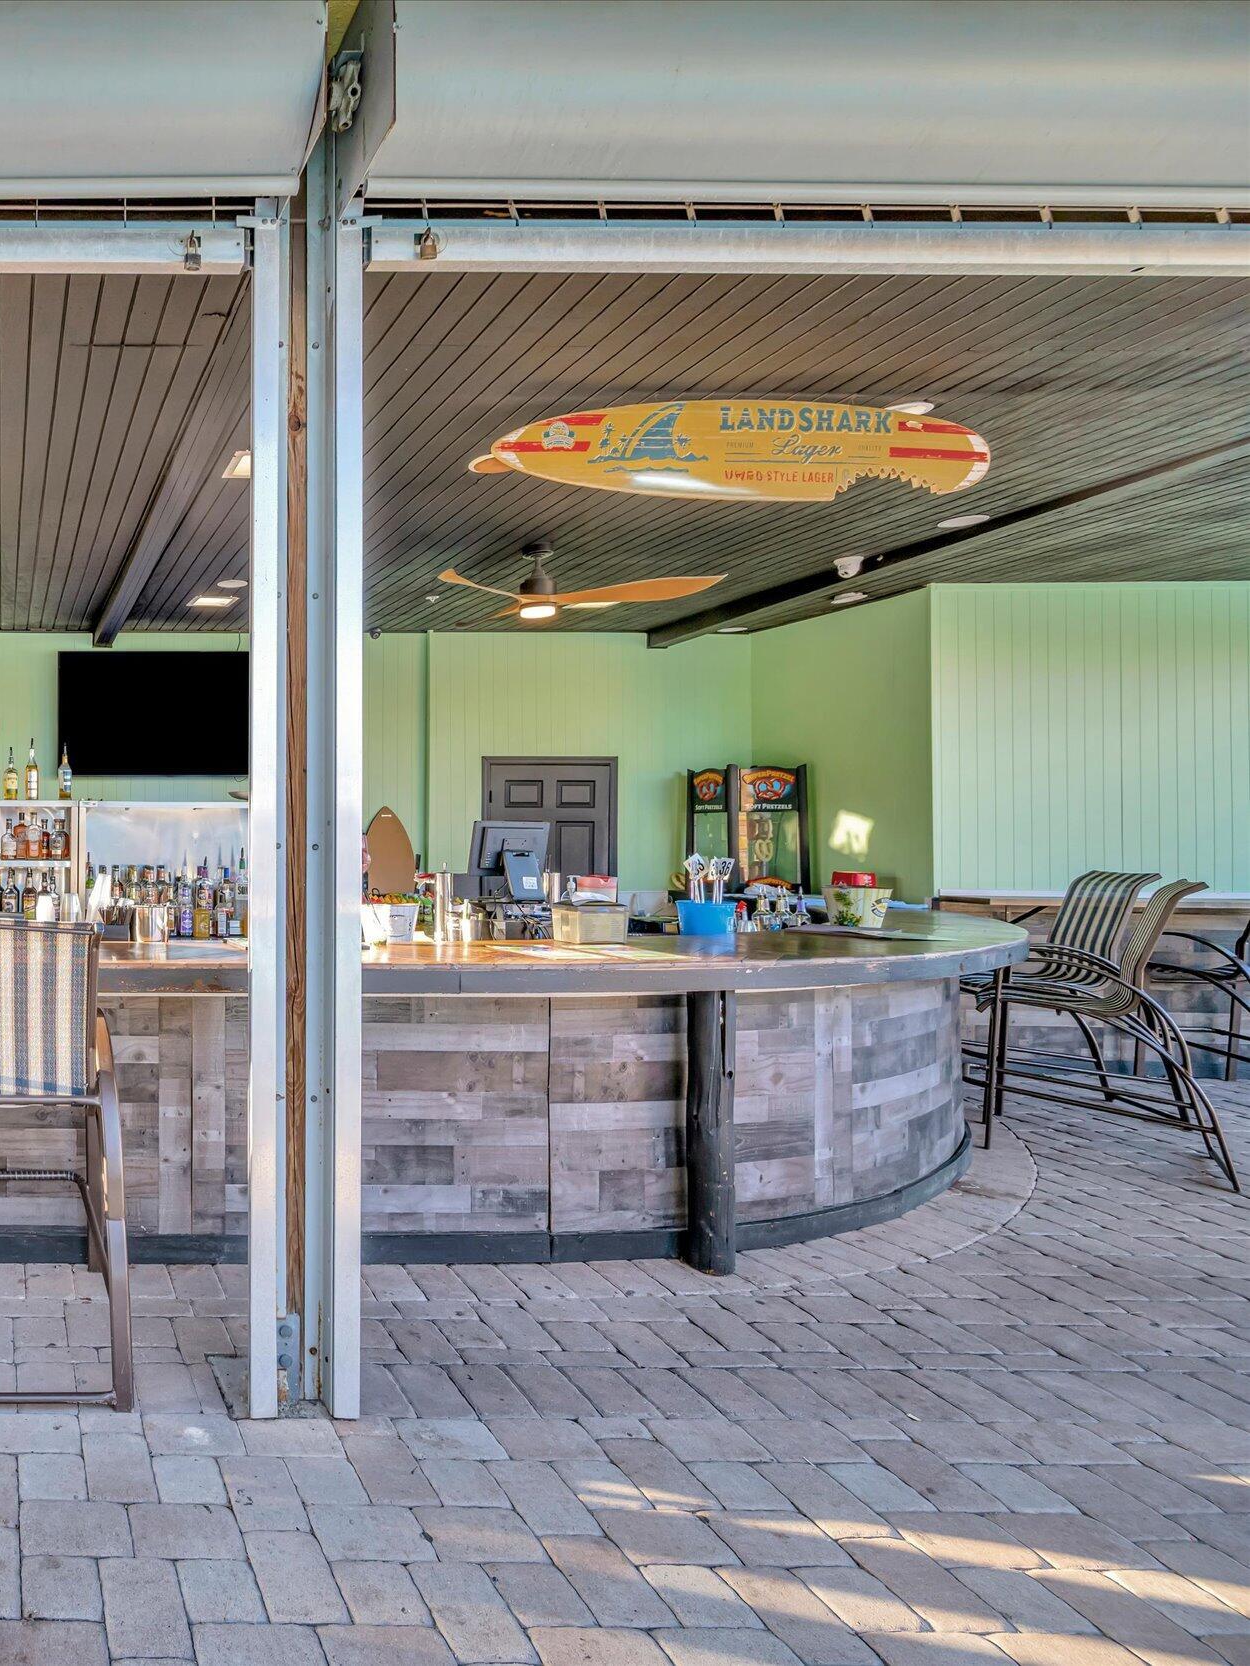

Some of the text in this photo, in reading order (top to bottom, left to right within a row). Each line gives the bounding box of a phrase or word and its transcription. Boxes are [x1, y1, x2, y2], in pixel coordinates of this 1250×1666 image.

[719, 406, 892, 434] LANDSHARK
[771, 434, 843, 464] Lager
[767, 471, 798, 482] STYLE
[802, 471, 834, 483] LAGER
[719, 861, 732, 876] 36
